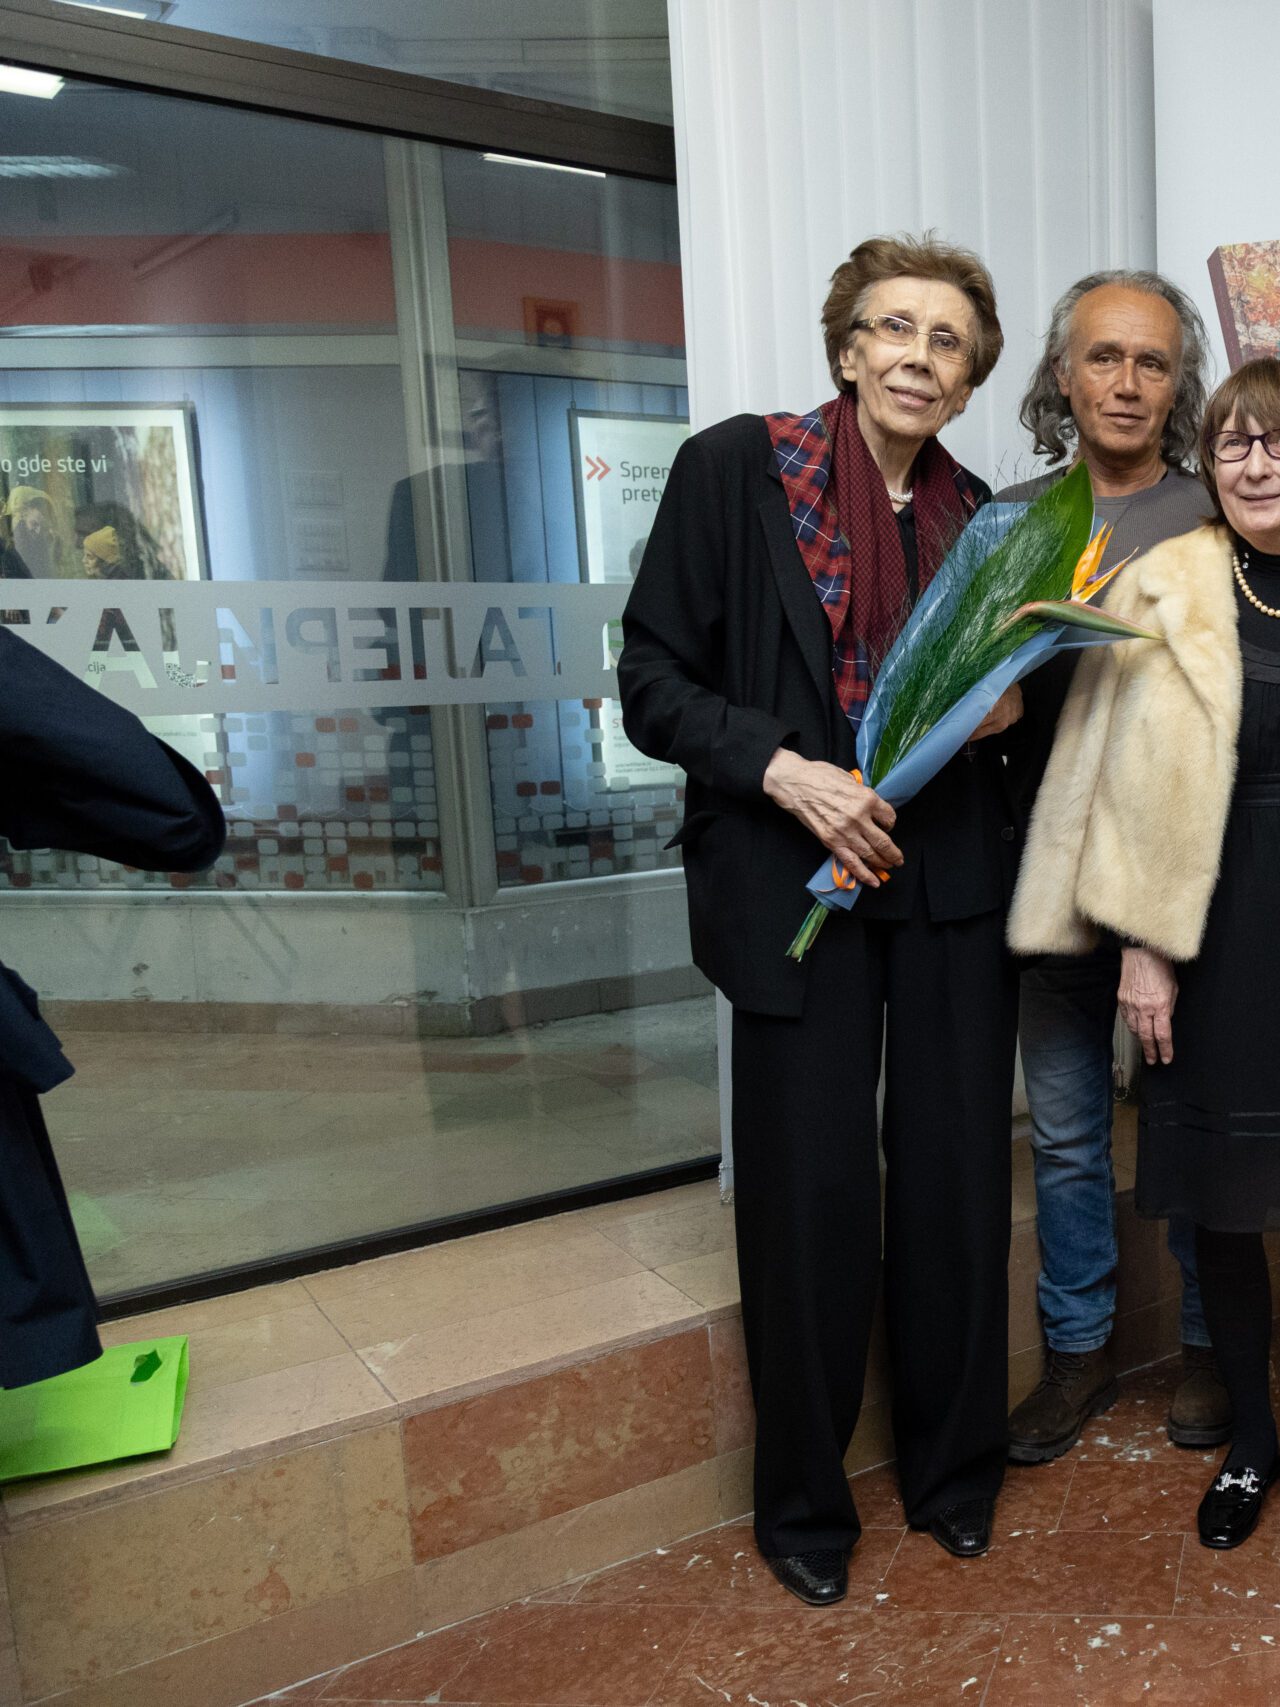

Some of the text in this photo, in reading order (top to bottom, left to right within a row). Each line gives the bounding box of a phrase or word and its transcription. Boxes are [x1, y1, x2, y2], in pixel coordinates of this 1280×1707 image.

[18, 454, 51, 477] gde
[57, 456, 86, 473] ste
[91, 455, 108, 473] vi
